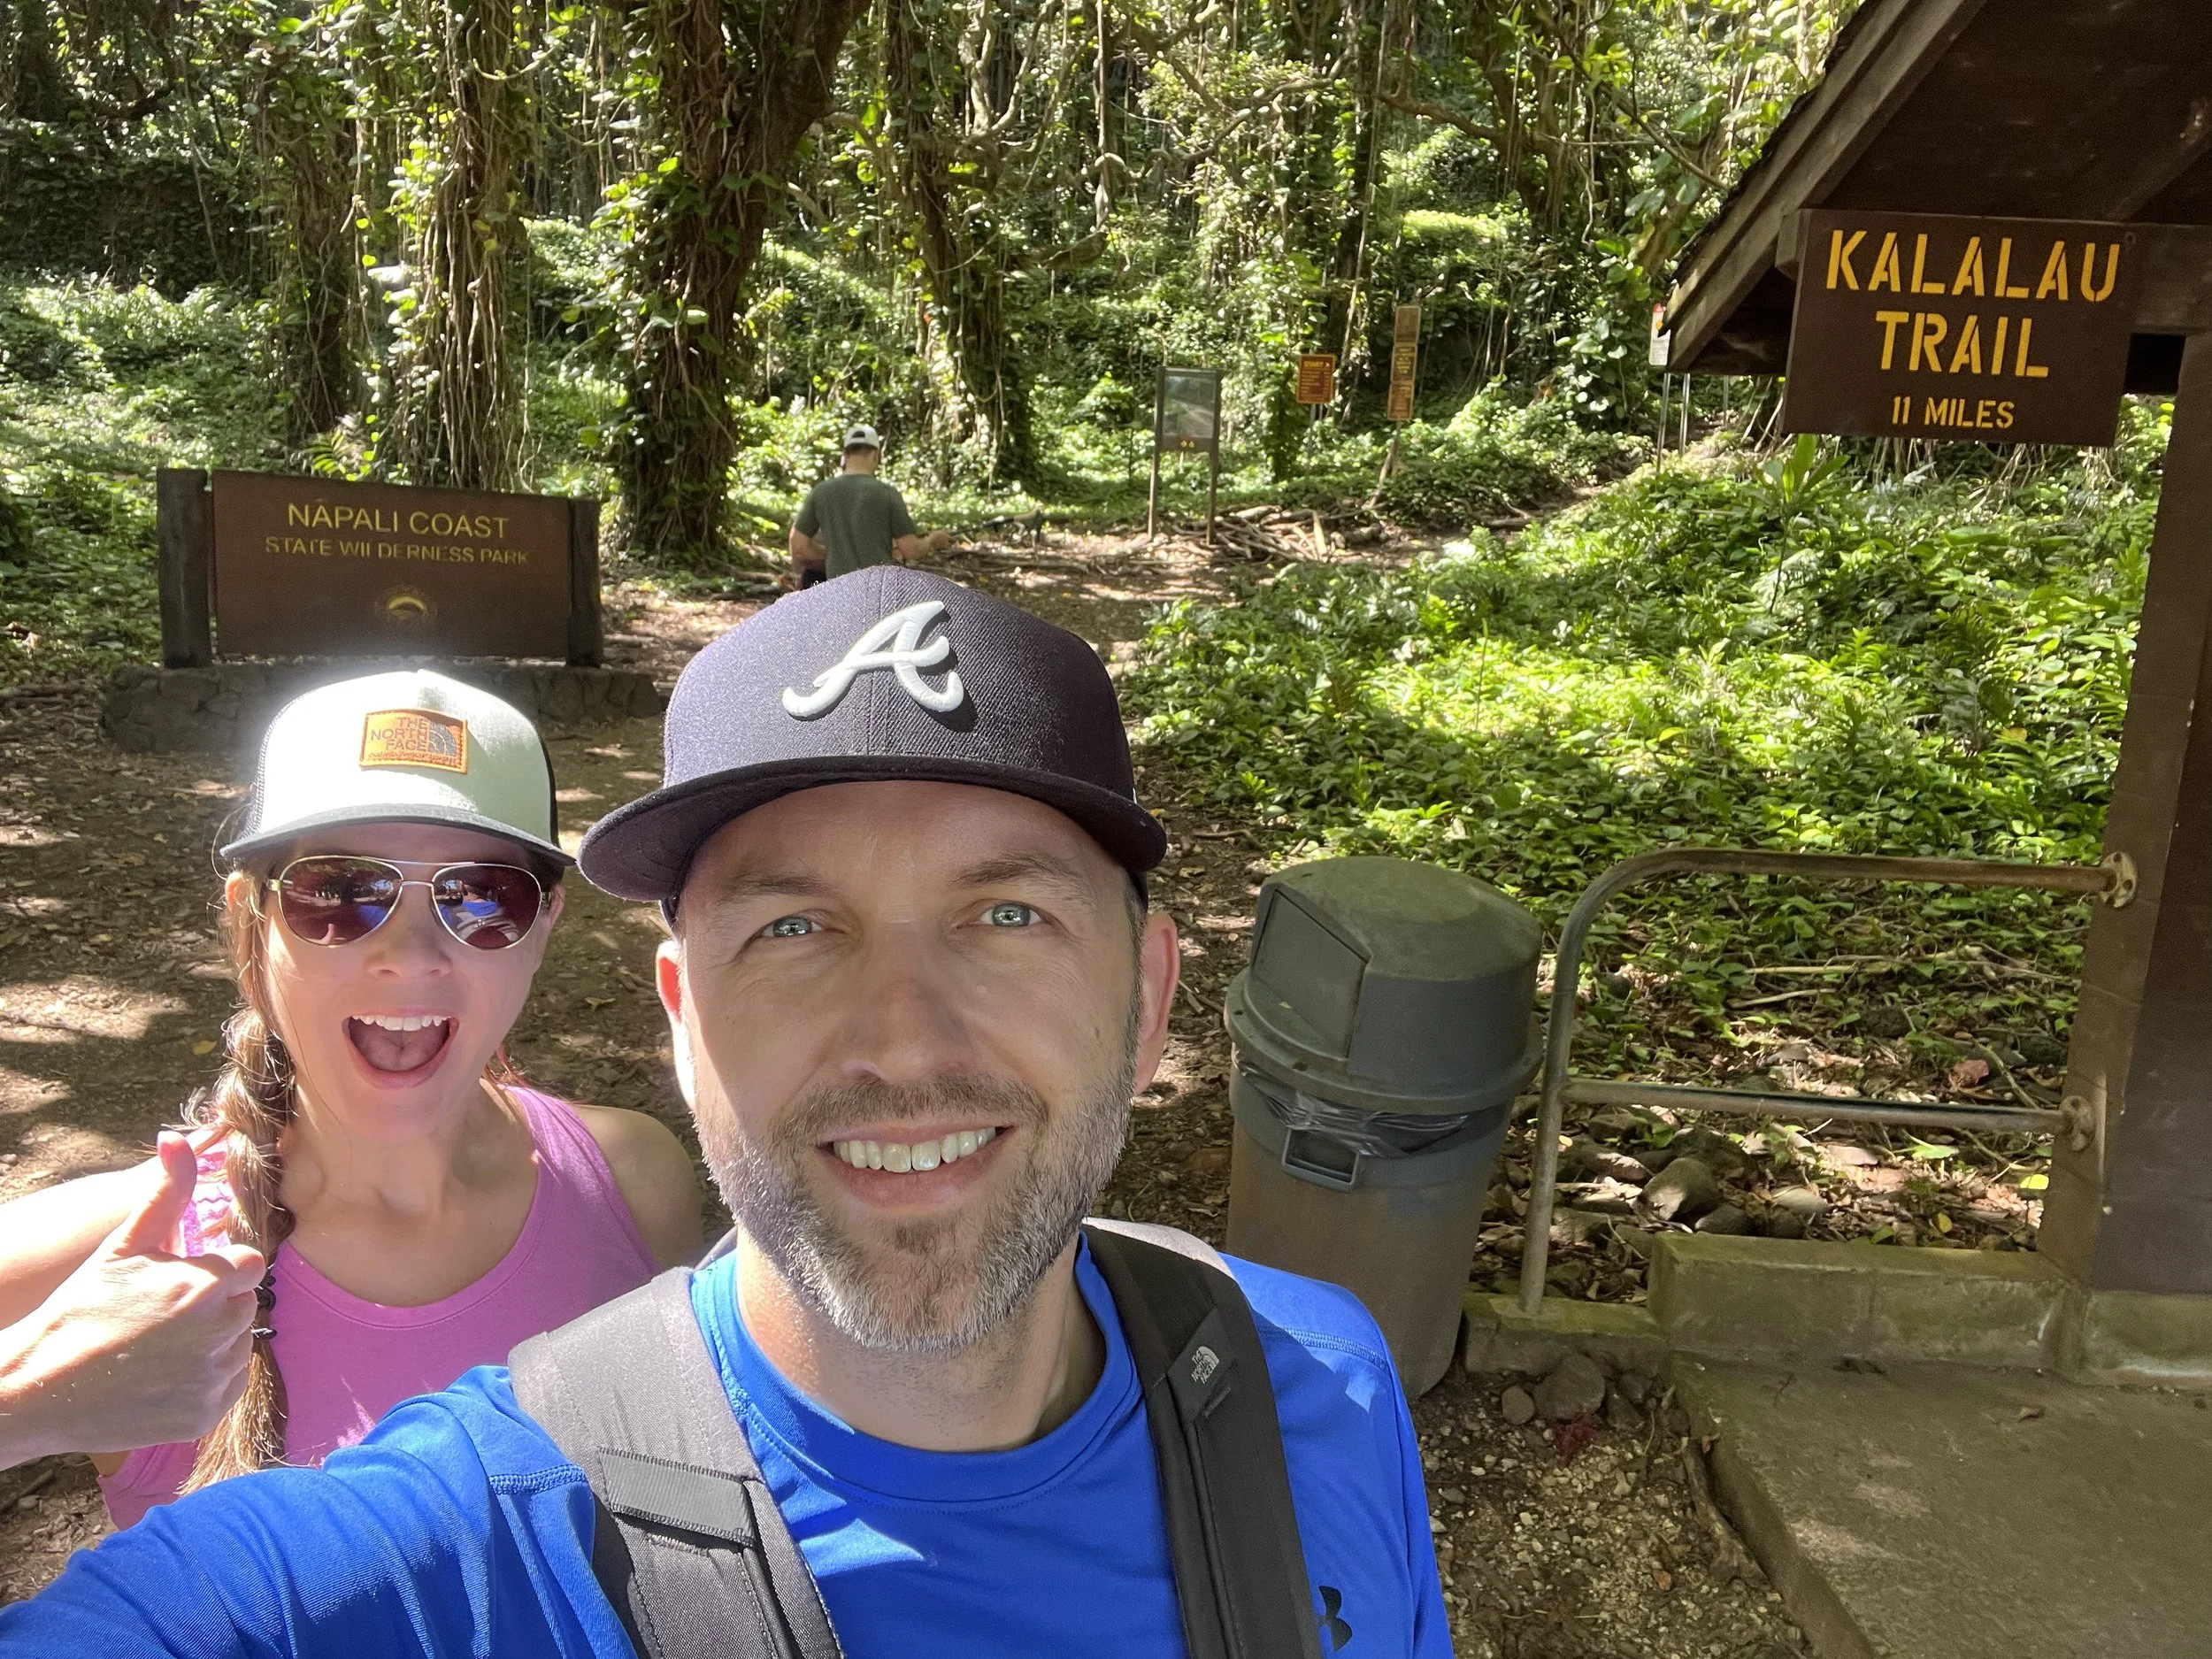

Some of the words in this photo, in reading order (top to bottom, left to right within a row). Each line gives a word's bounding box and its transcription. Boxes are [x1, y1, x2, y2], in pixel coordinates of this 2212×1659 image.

[1825, 229, 2121, 303] KALALAU
[1875, 310, 2050, 379] TRAIL
[1891, 396, 1911, 426] 11
[1924, 396, 2016, 429] MILES
[409, 511, 509, 539] COAST
[265, 535, 334, 557] STATE
[480, 547, 530, 565] PARK
[781, 600, 964, 717] A
[371, 727, 428, 741] NORTH
[396, 717, 428, 730] THE
[385, 739, 427, 752] FACE
